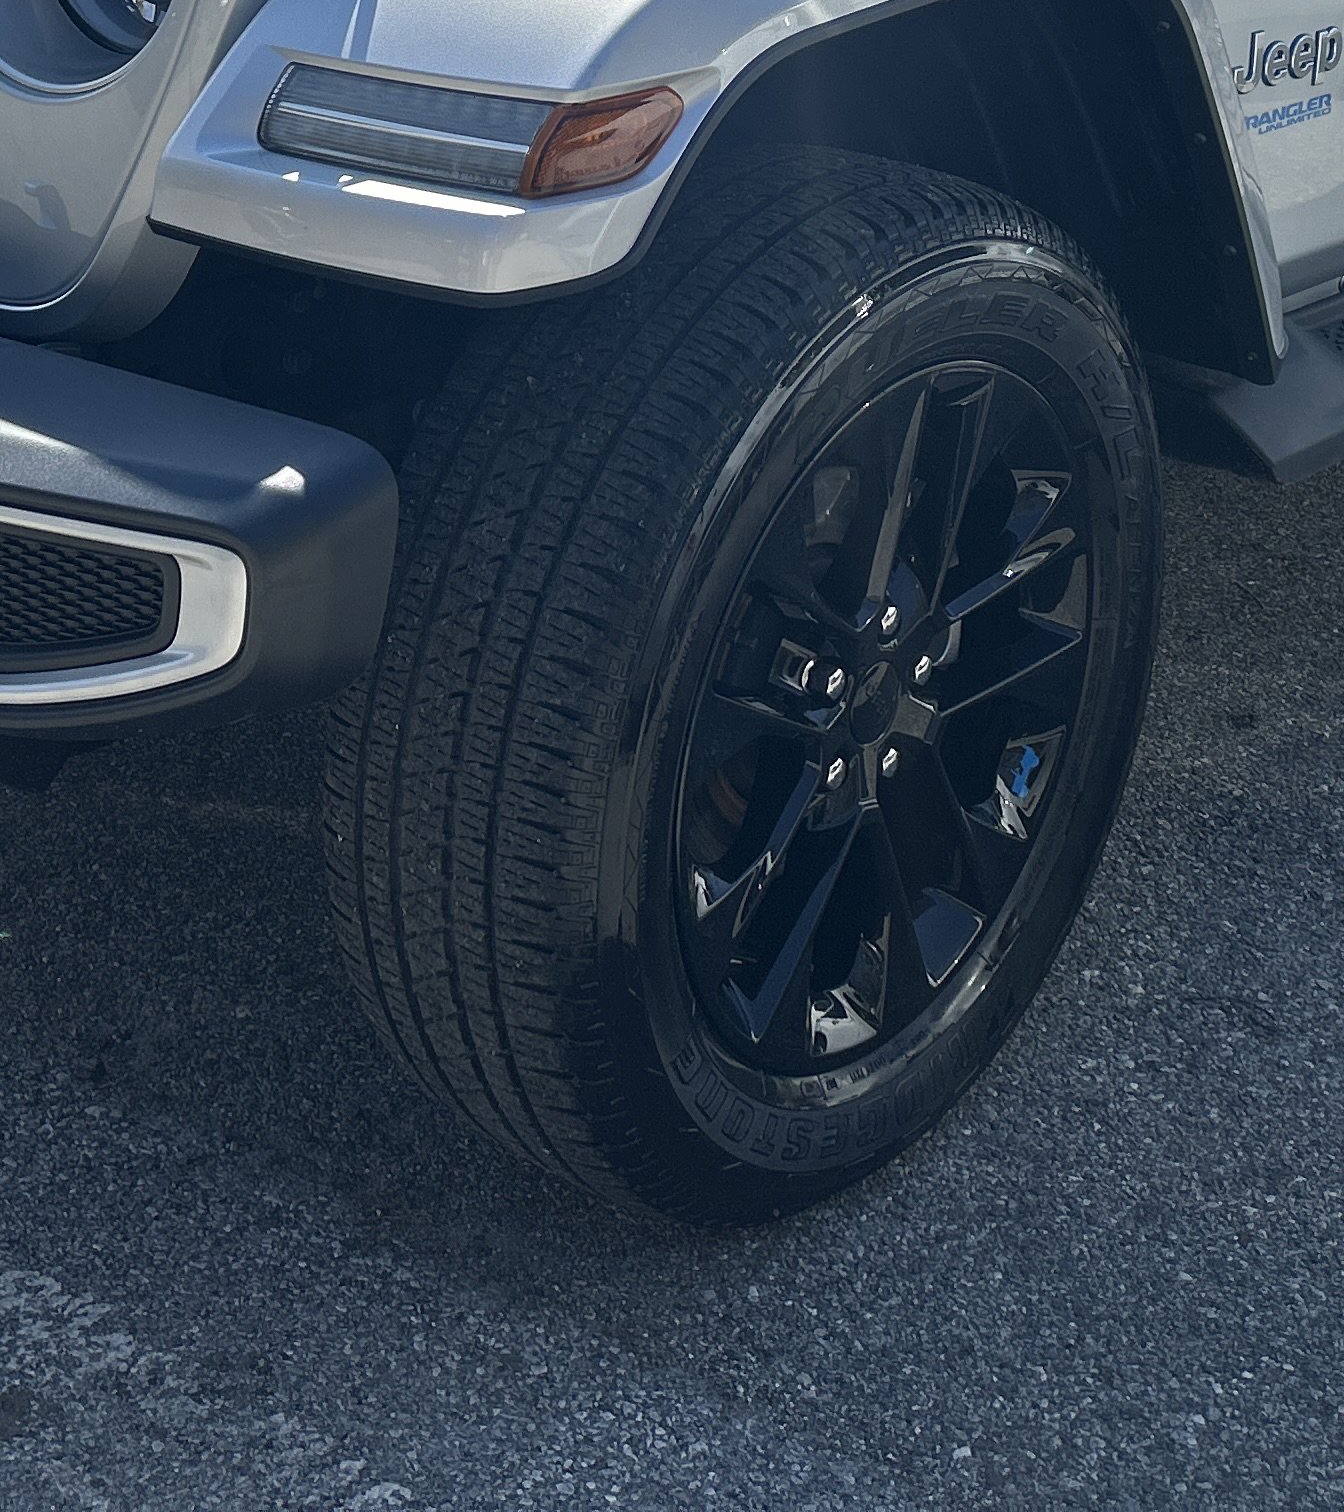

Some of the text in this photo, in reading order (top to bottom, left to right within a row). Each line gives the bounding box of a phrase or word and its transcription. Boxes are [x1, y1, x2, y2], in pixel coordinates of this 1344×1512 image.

[1232, 26, 1343, 94] Jeep
[1244, 93, 1332, 130] RANGLER
[1258, 108, 1332, 135] UNLIMITED
